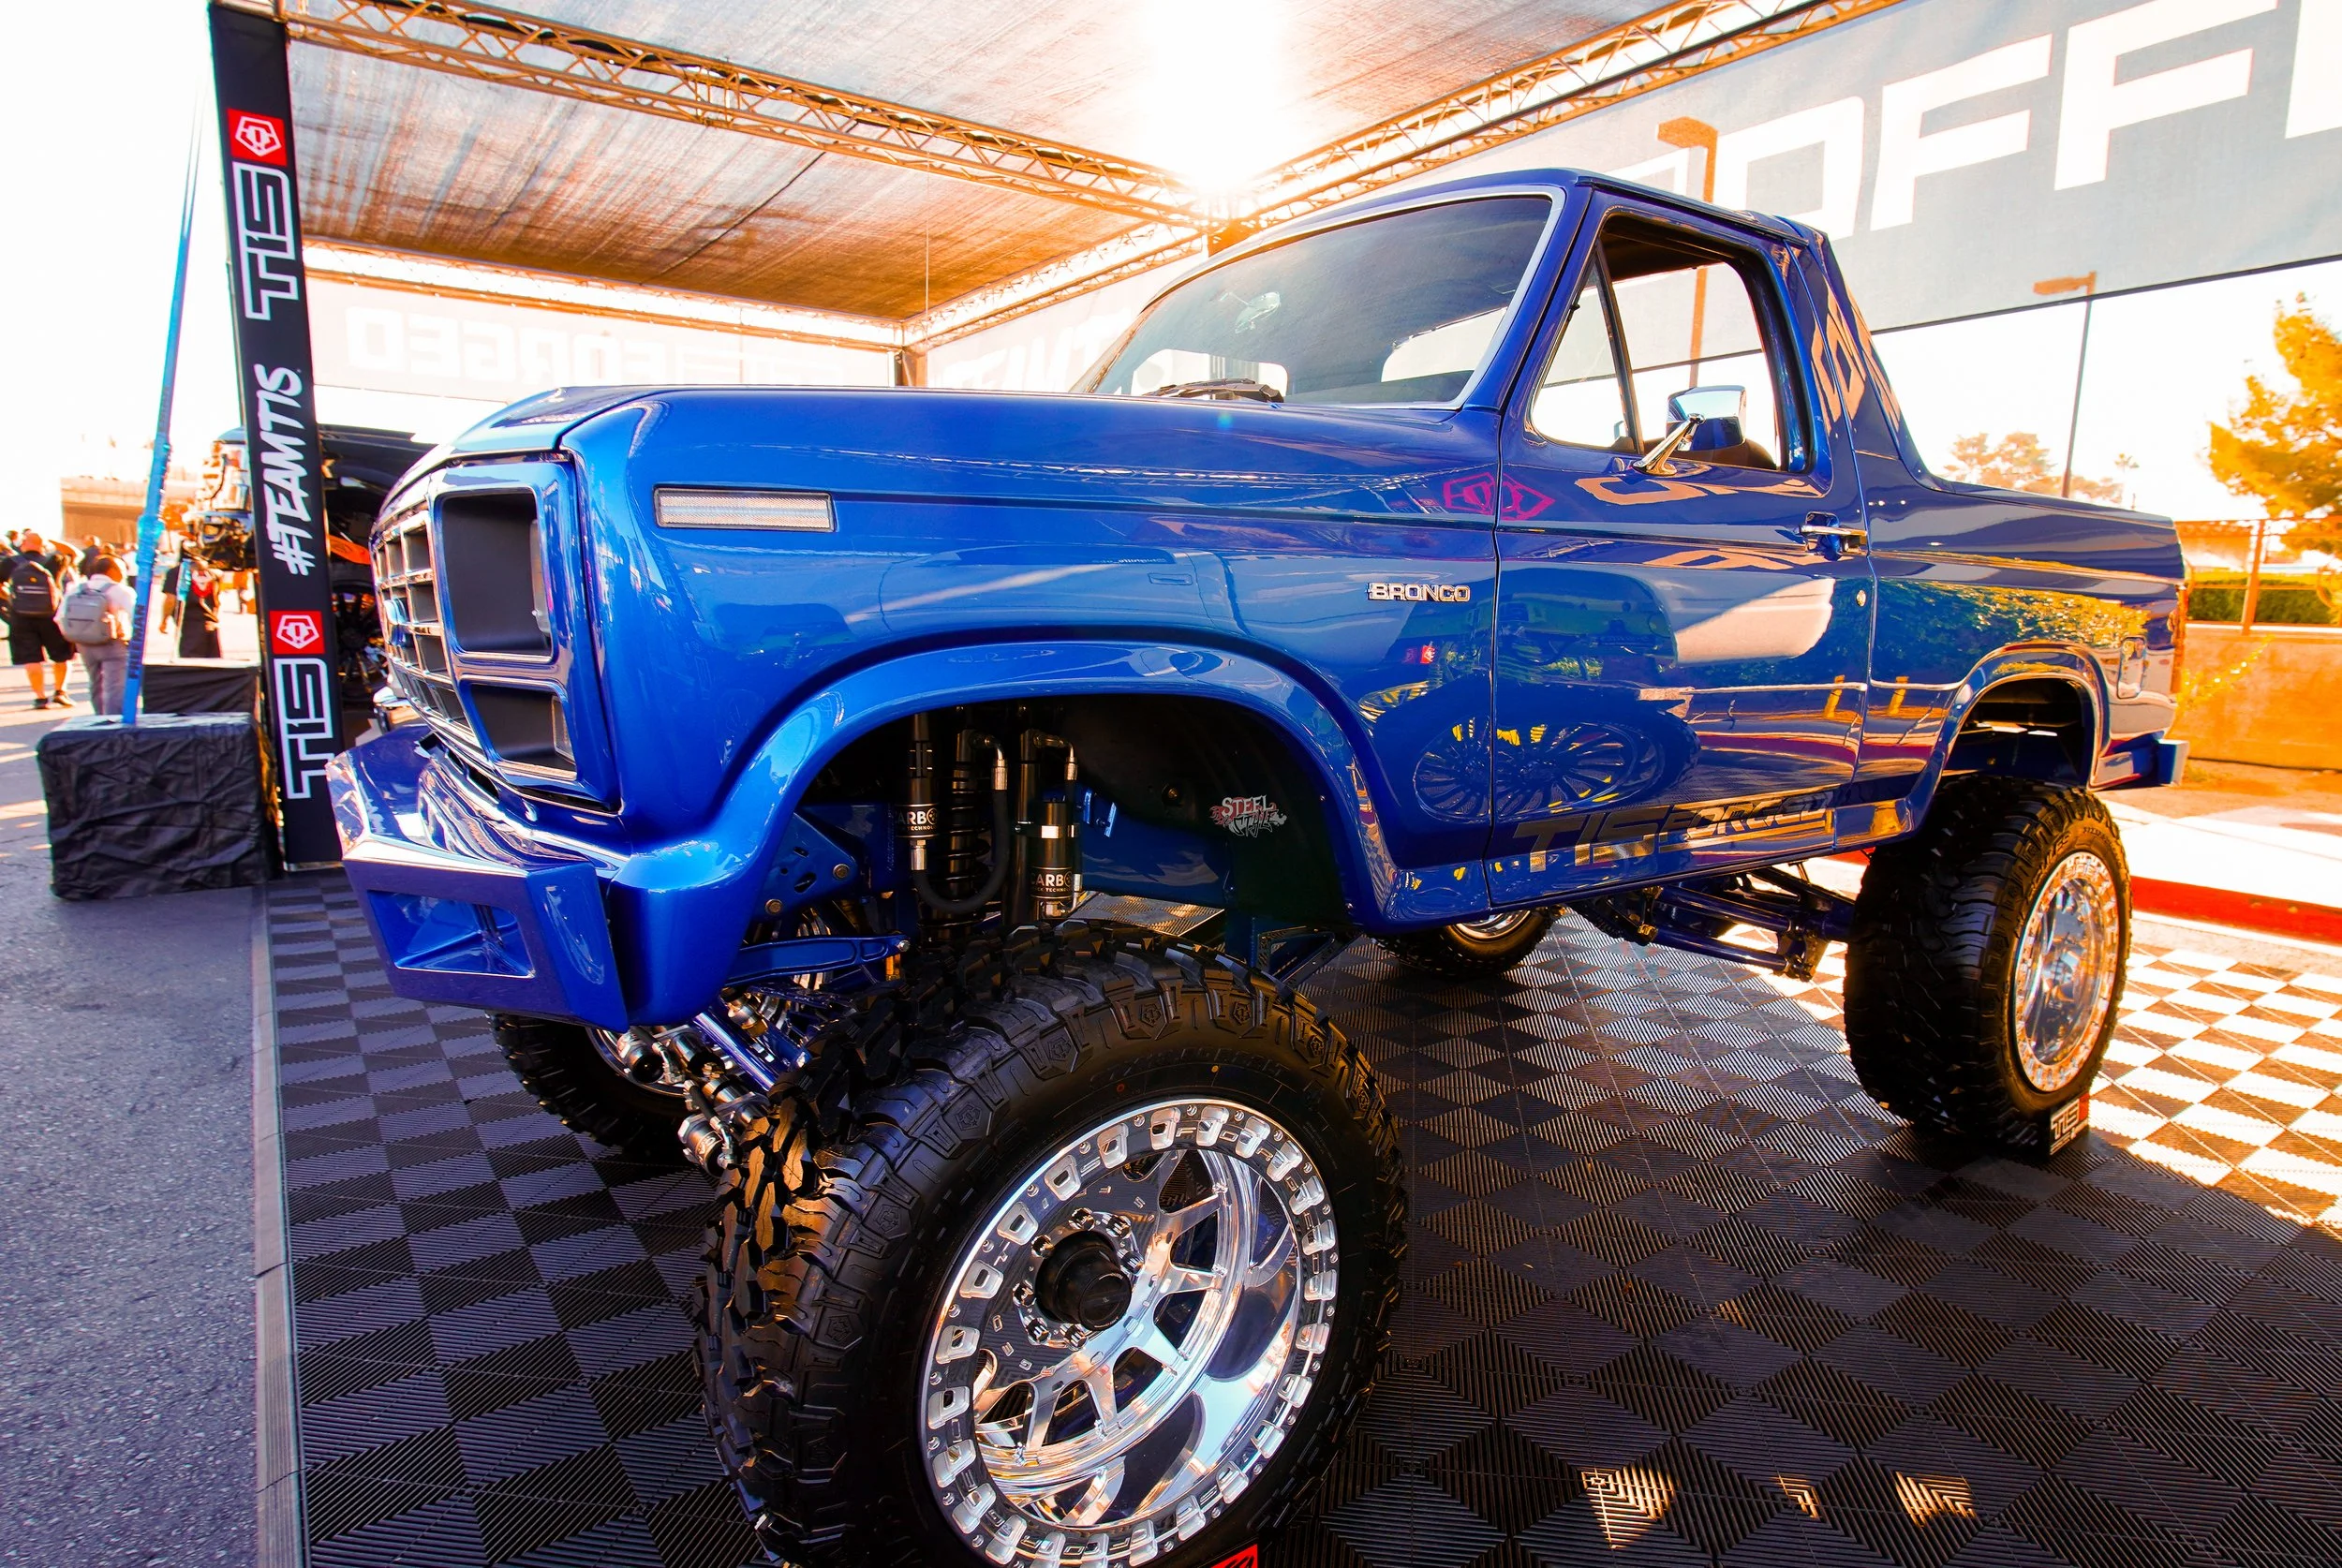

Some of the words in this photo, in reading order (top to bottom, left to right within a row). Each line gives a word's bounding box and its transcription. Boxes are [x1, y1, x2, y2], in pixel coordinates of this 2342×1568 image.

[253, 362, 317, 577] #TEAMTIS
[1368, 582, 1471, 602] BRONCO
[1221, 794, 1274, 817] STEEL
